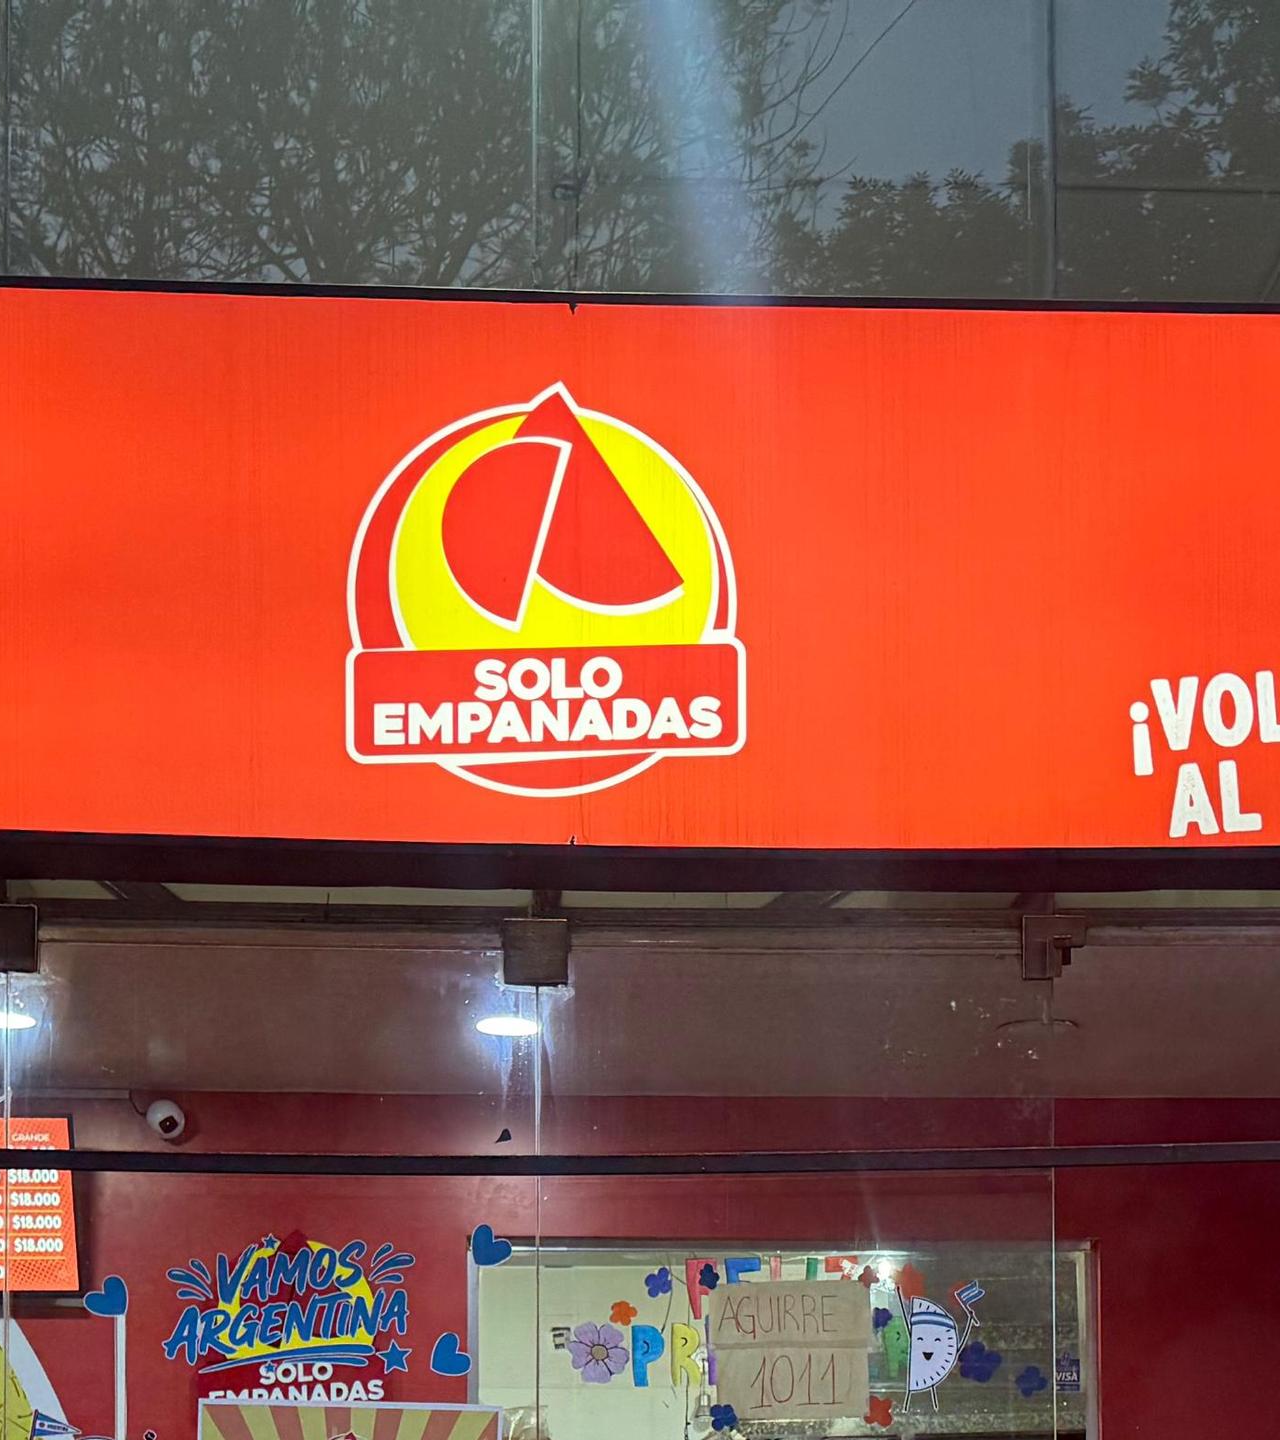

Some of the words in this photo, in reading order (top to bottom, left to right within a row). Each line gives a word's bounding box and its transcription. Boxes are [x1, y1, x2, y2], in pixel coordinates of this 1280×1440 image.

[473, 656, 623, 701] SOLO
[373, 696, 723, 746] EMPANADAS
[1168, 760, 1263, 838] AL
[11, 1133, 50, 1142] GRANDE
[8, 1168, 59, 1184] $18.000
[10, 1191, 61, 1208] $18.000
[11, 1214, 62, 1230] $18.000
[14, 1238, 64, 1254] $18.000
[217, 1239, 367, 1304] VAMOS
[161, 1288, 409, 1365] ARGENTINA
[718, 1295, 839, 1340] AGUIRRE
[259, 1362, 333, 1386] SOLO
[750, 1353, 844, 1410] 1011
[1055, 1371, 1079, 1381] VISA
